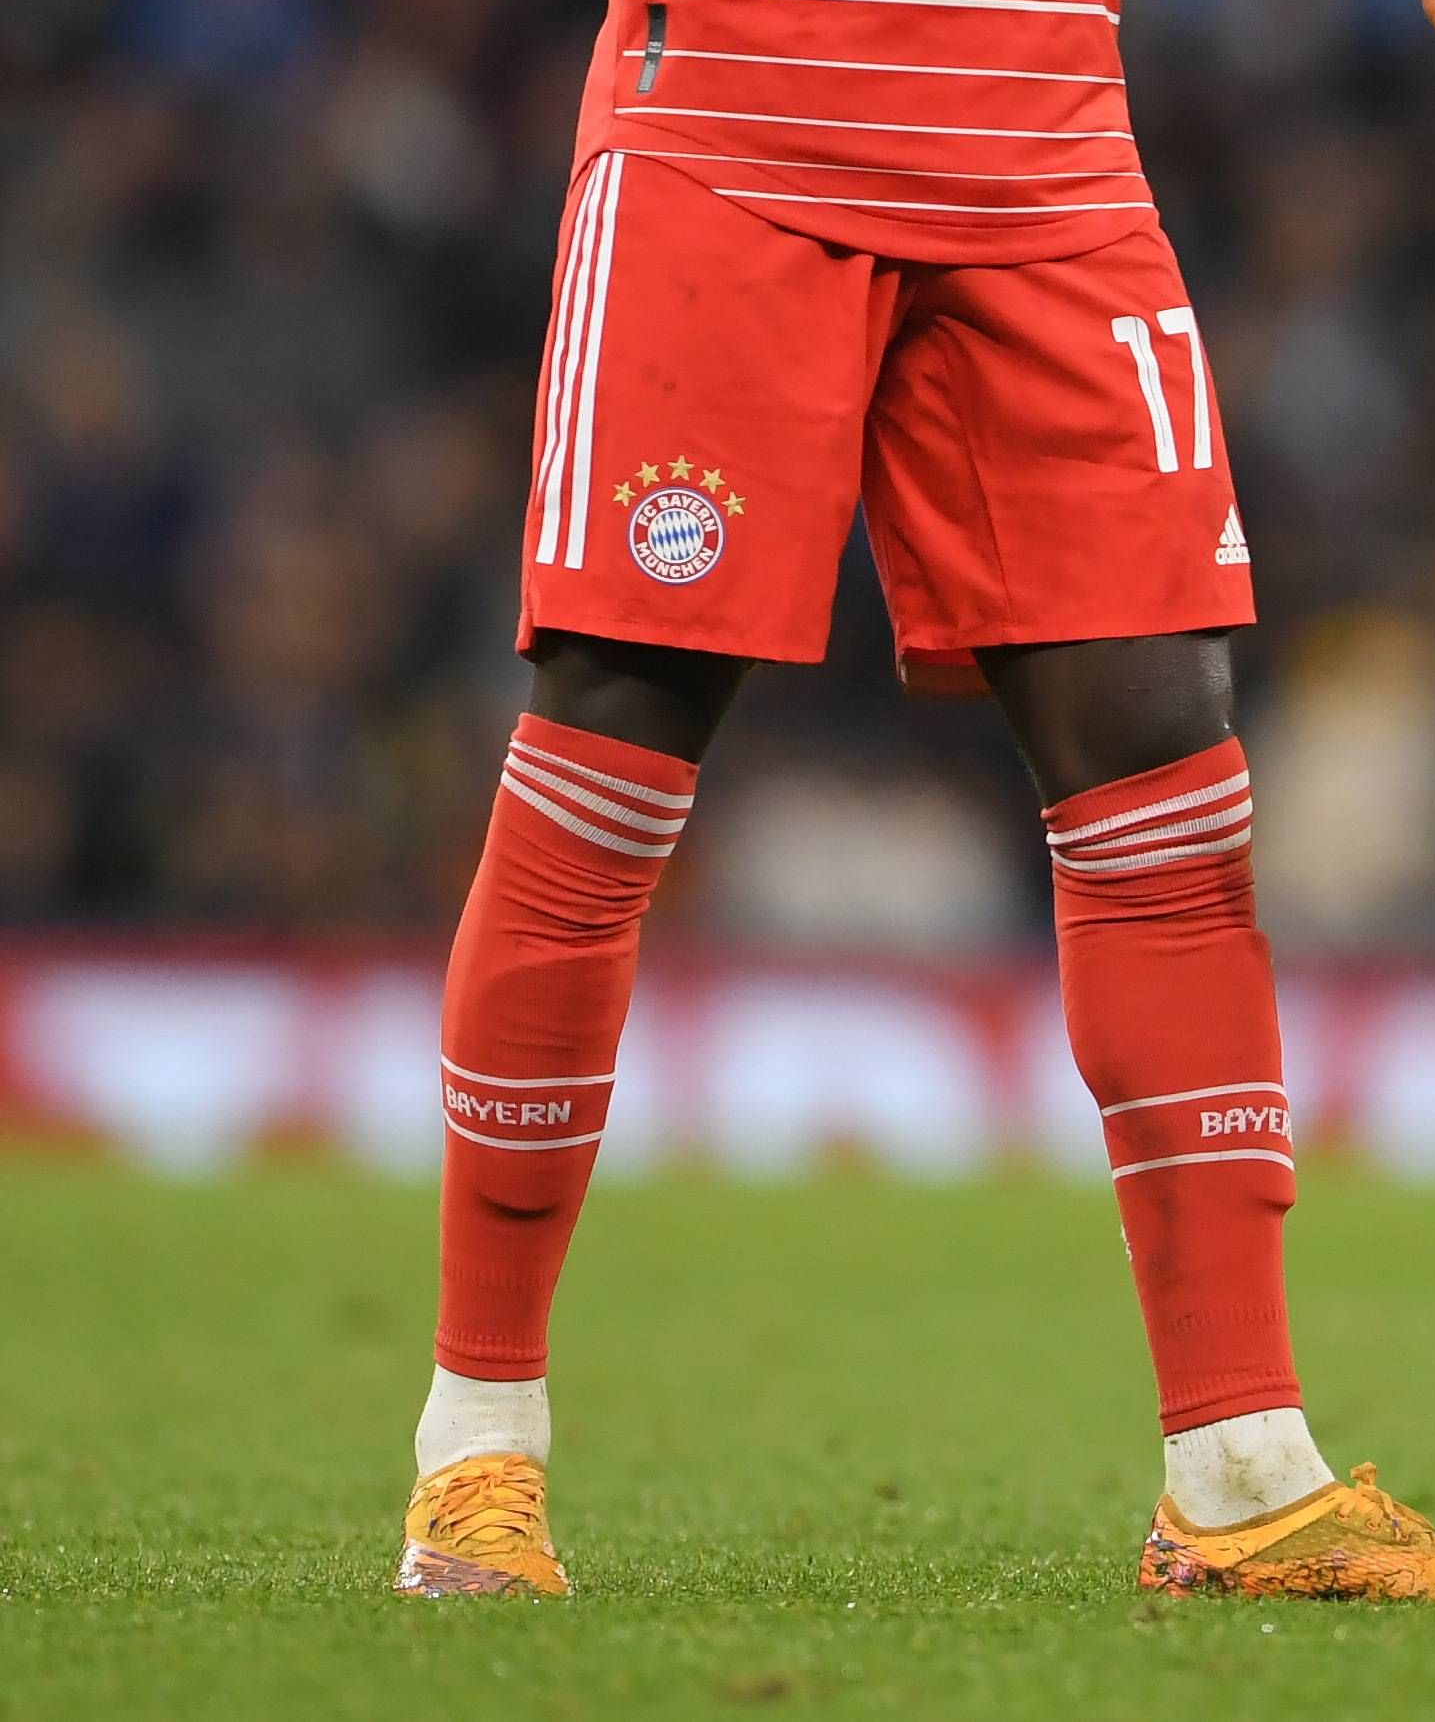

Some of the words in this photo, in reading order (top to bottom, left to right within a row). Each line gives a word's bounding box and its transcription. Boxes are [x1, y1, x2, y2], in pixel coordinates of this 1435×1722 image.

[1110, 306, 1213, 474] 17
[637, 504, 658, 527] FC
[657, 494, 718, 533] BAYERN
[445, 1083, 572, 1126] BAYERN
[1200, 1106, 1293, 1144] BAYER
